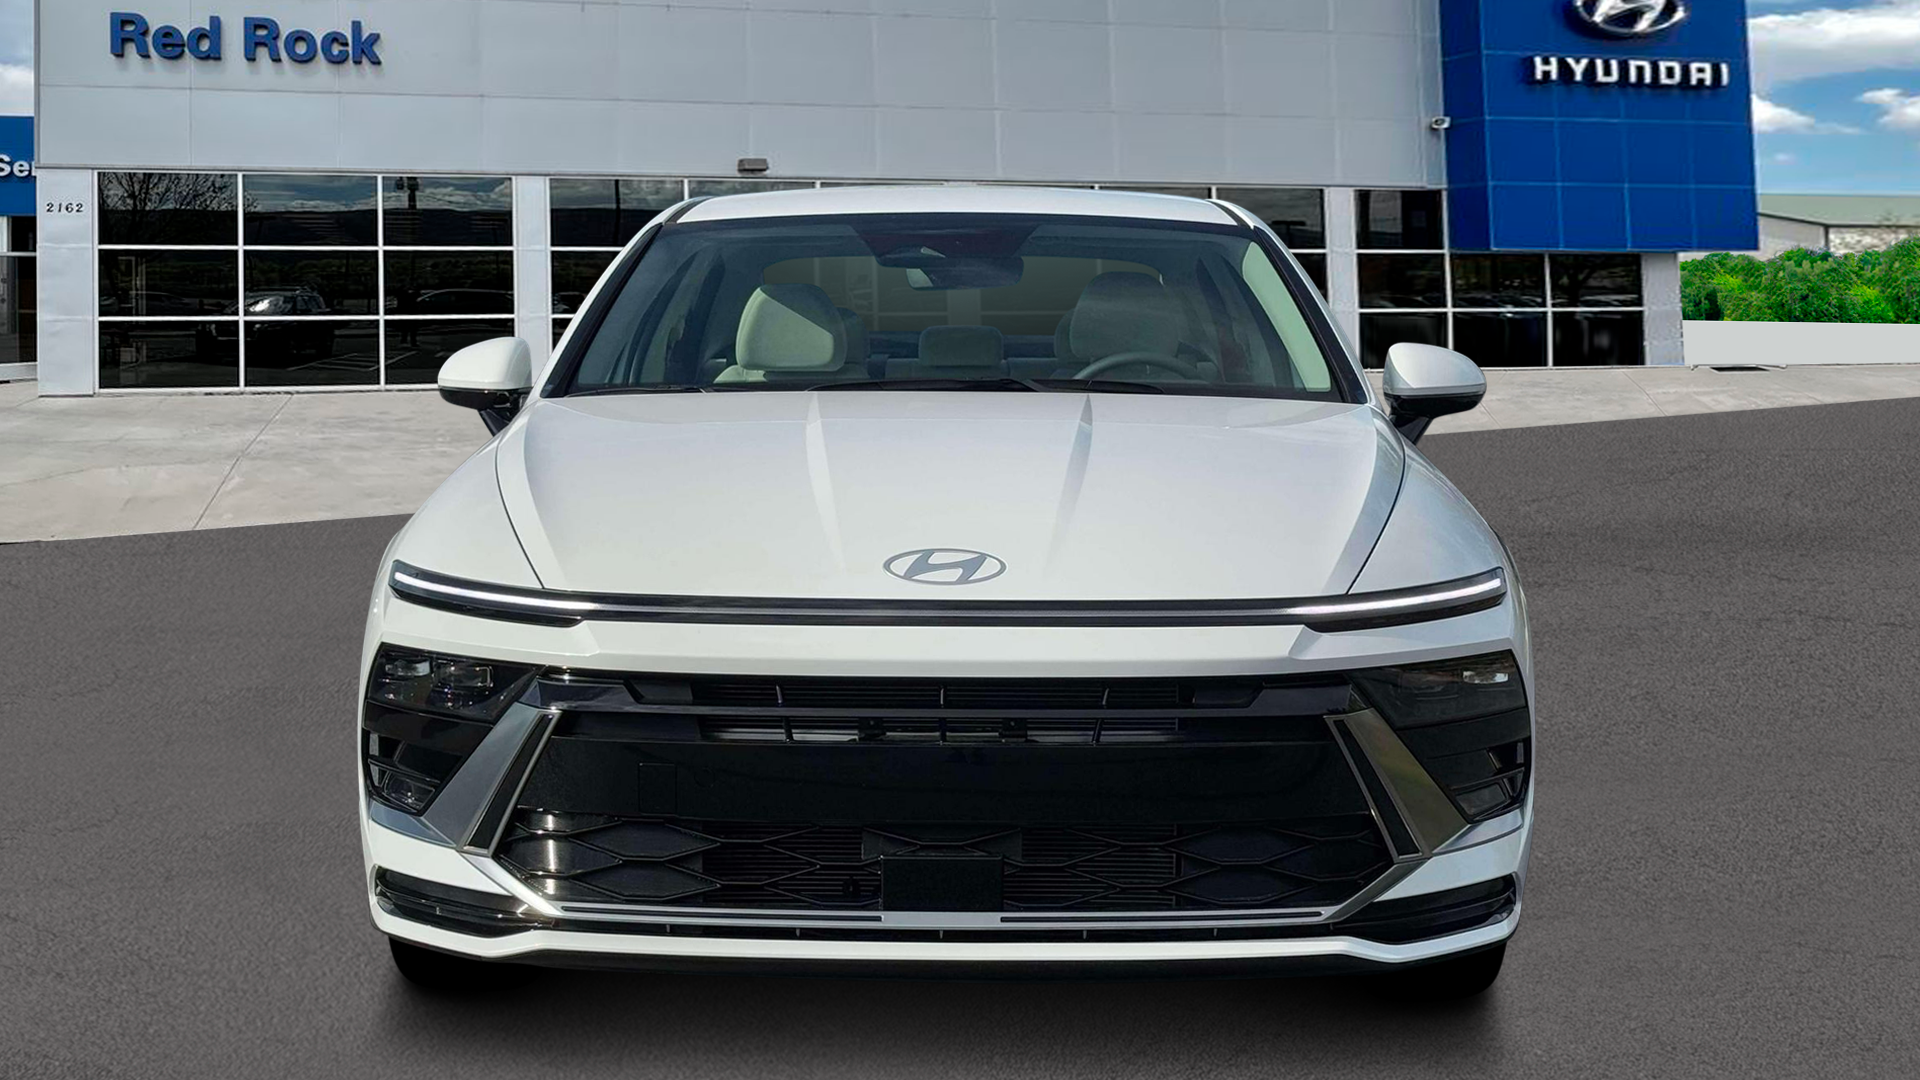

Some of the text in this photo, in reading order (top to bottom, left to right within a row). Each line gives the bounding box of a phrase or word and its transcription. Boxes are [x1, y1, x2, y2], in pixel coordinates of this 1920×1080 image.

[109, 12, 382, 66] Red Rock
[1533, 55, 1730, 87] HYUNDAI
[45, 201, 84, 214] 2162
